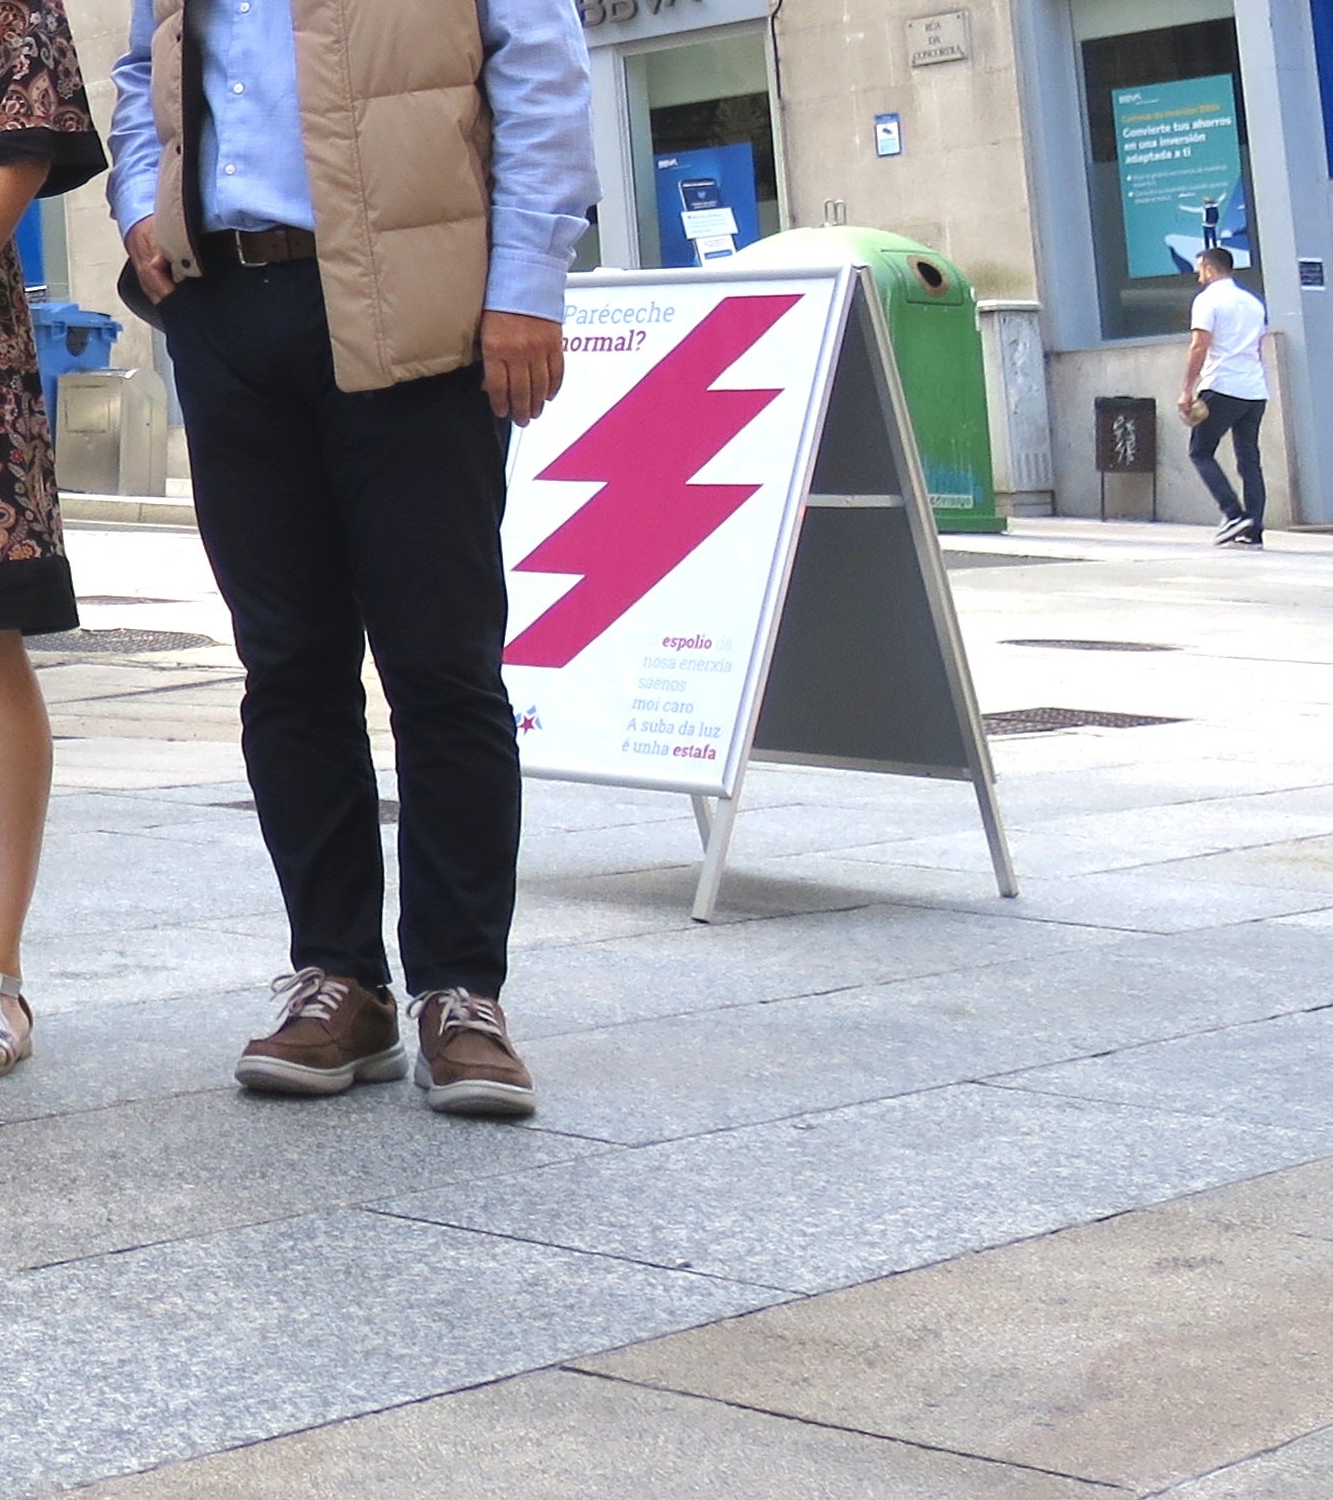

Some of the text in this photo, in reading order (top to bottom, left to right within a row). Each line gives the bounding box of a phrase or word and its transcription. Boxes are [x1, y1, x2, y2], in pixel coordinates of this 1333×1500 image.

[1123, 117, 1232, 138] Convierte tus ahorros
[1124, 132, 1206, 151] en una inversión
[1125, 149, 1172, 165] adaptada
[563, 301, 675, 324] Paréceche
[662, 634, 713, 652] espolio
[643, 656, 676, 669] nosa
[632, 697, 694, 714] moi caro
[626, 717, 722, 739] A suba da luz
[633, 740, 670, 756] unha
[673, 743, 717, 760] estafa
